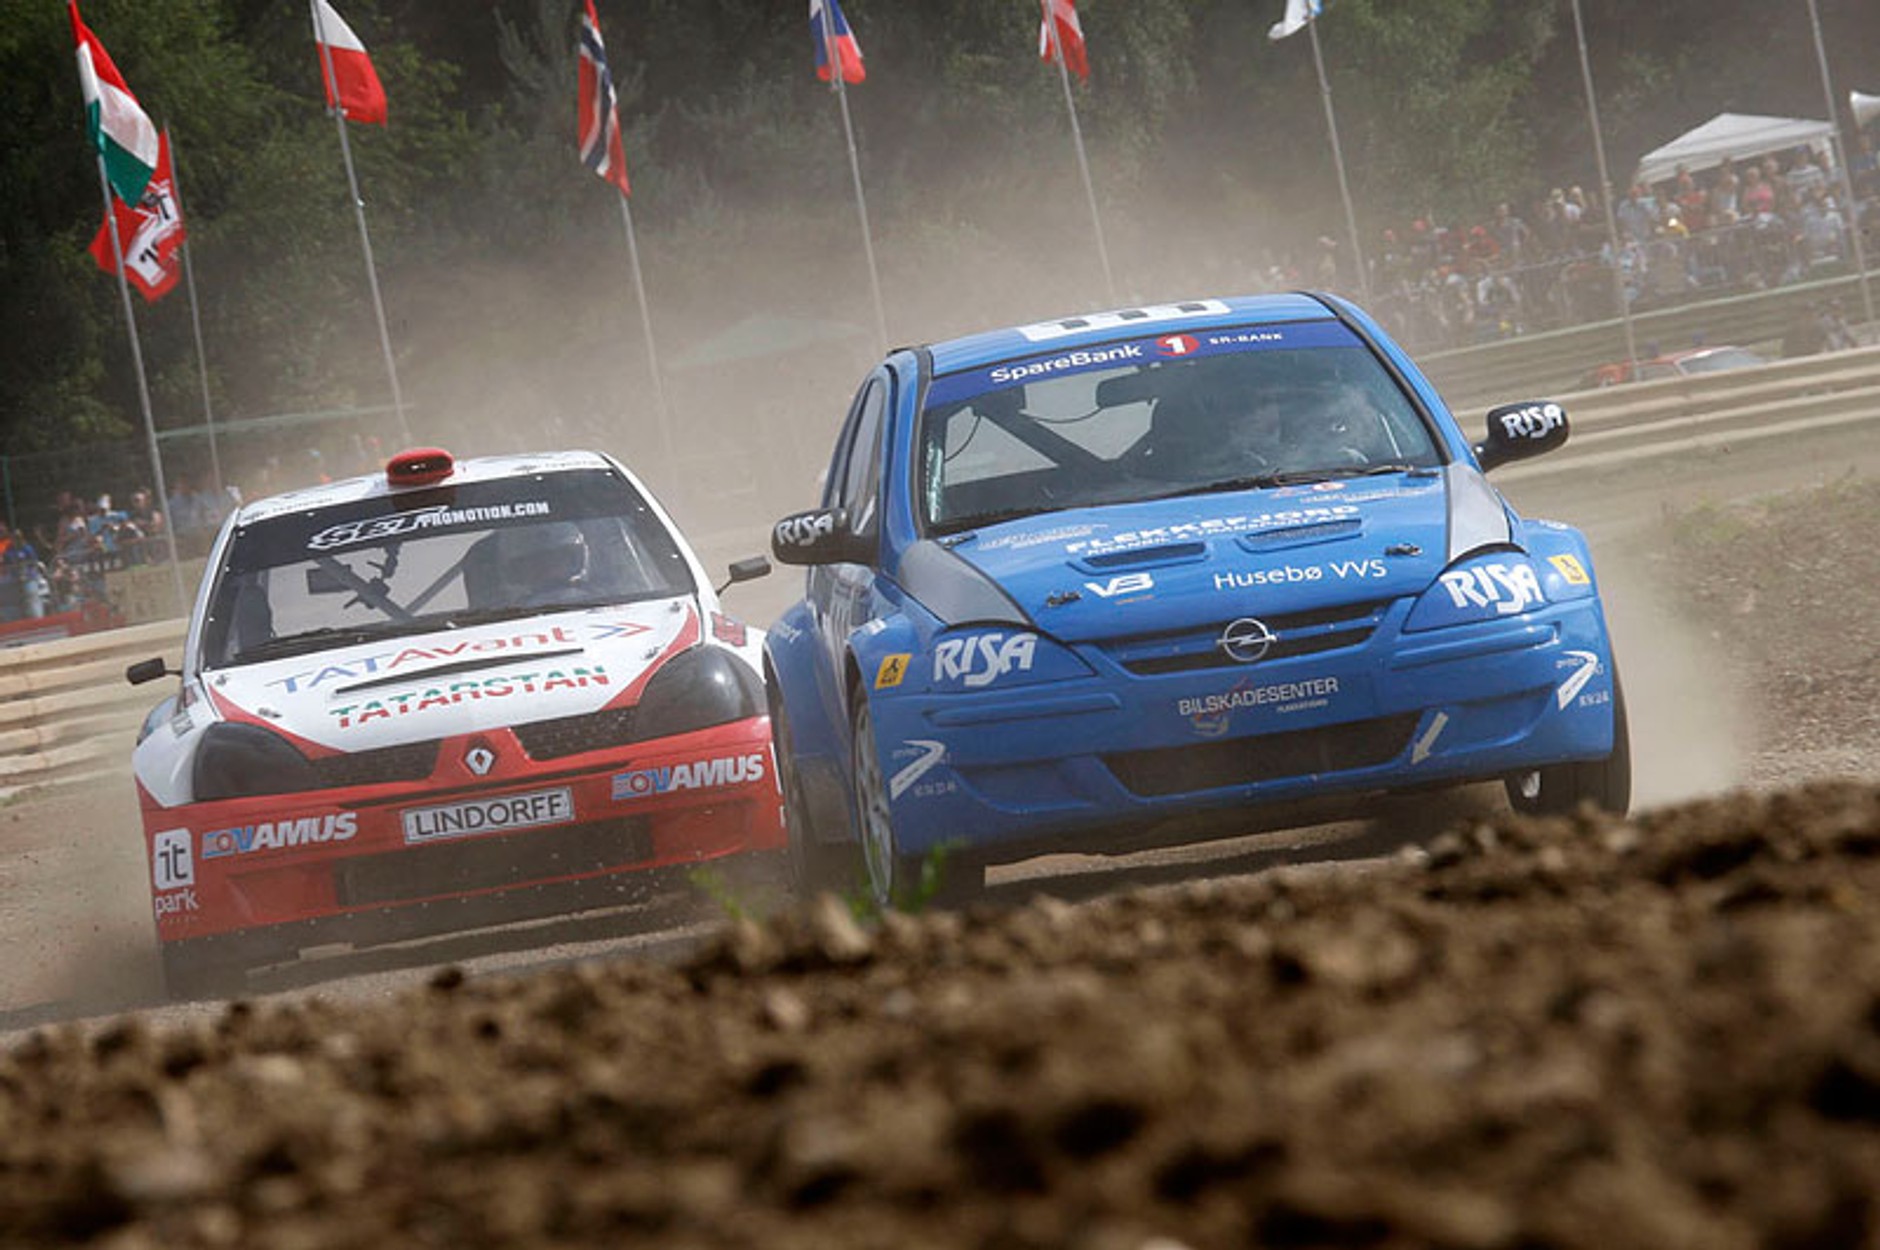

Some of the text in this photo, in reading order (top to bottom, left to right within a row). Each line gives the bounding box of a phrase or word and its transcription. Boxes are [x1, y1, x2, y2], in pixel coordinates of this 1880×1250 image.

[989, 343, 1143, 383] SpareBank
[1165, 335, 1188, 354] 1
[1501, 403, 1564, 438] RISA
[775, 513, 834, 547] RISA
[1213, 558, 1388, 591] Husebø VVS
[1439, 563, 1545, 614] RISA
[933, 632, 1039, 687] RISA
[330, 665, 611, 728] TATARSTAN
[1178, 676, 1340, 716] BILSKADESENTER
[413, 792, 562, 837] LINDORFF
[158, 838, 188, 882] it
[154, 888, 199, 921] park
